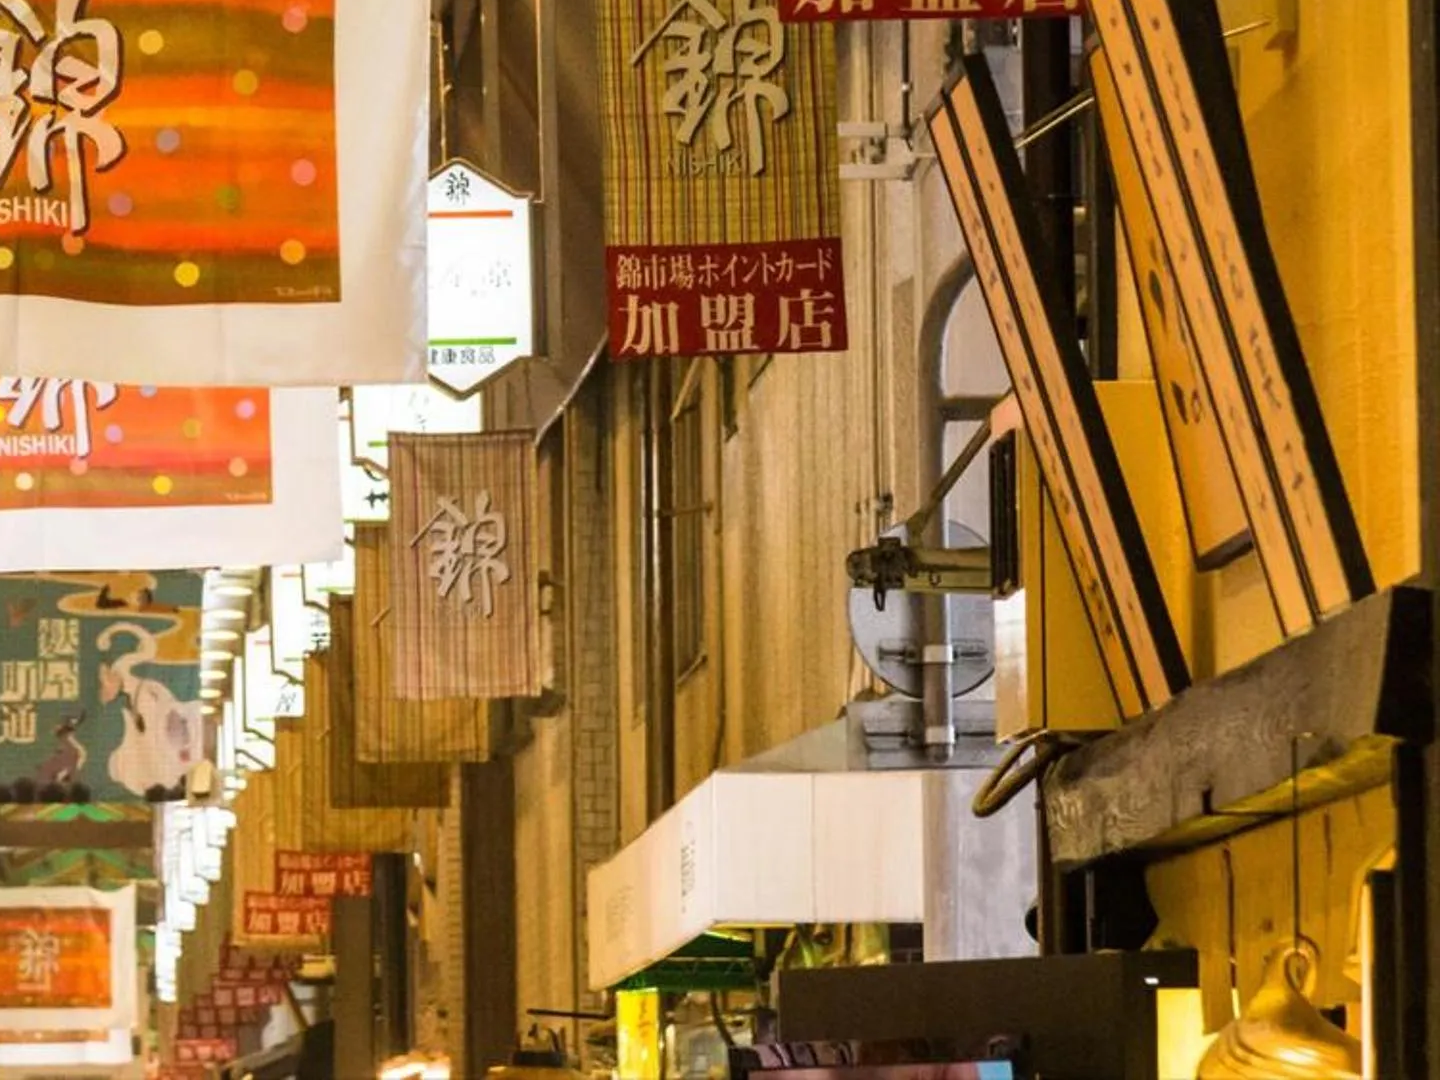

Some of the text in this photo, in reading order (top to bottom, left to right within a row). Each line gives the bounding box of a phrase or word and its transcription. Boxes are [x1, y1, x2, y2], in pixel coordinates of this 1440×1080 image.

[616, 248, 833, 291] 錦市場ポイントカード
[618, 288, 835, 355] 加盟店
[410, 490, 511, 619] 錦
